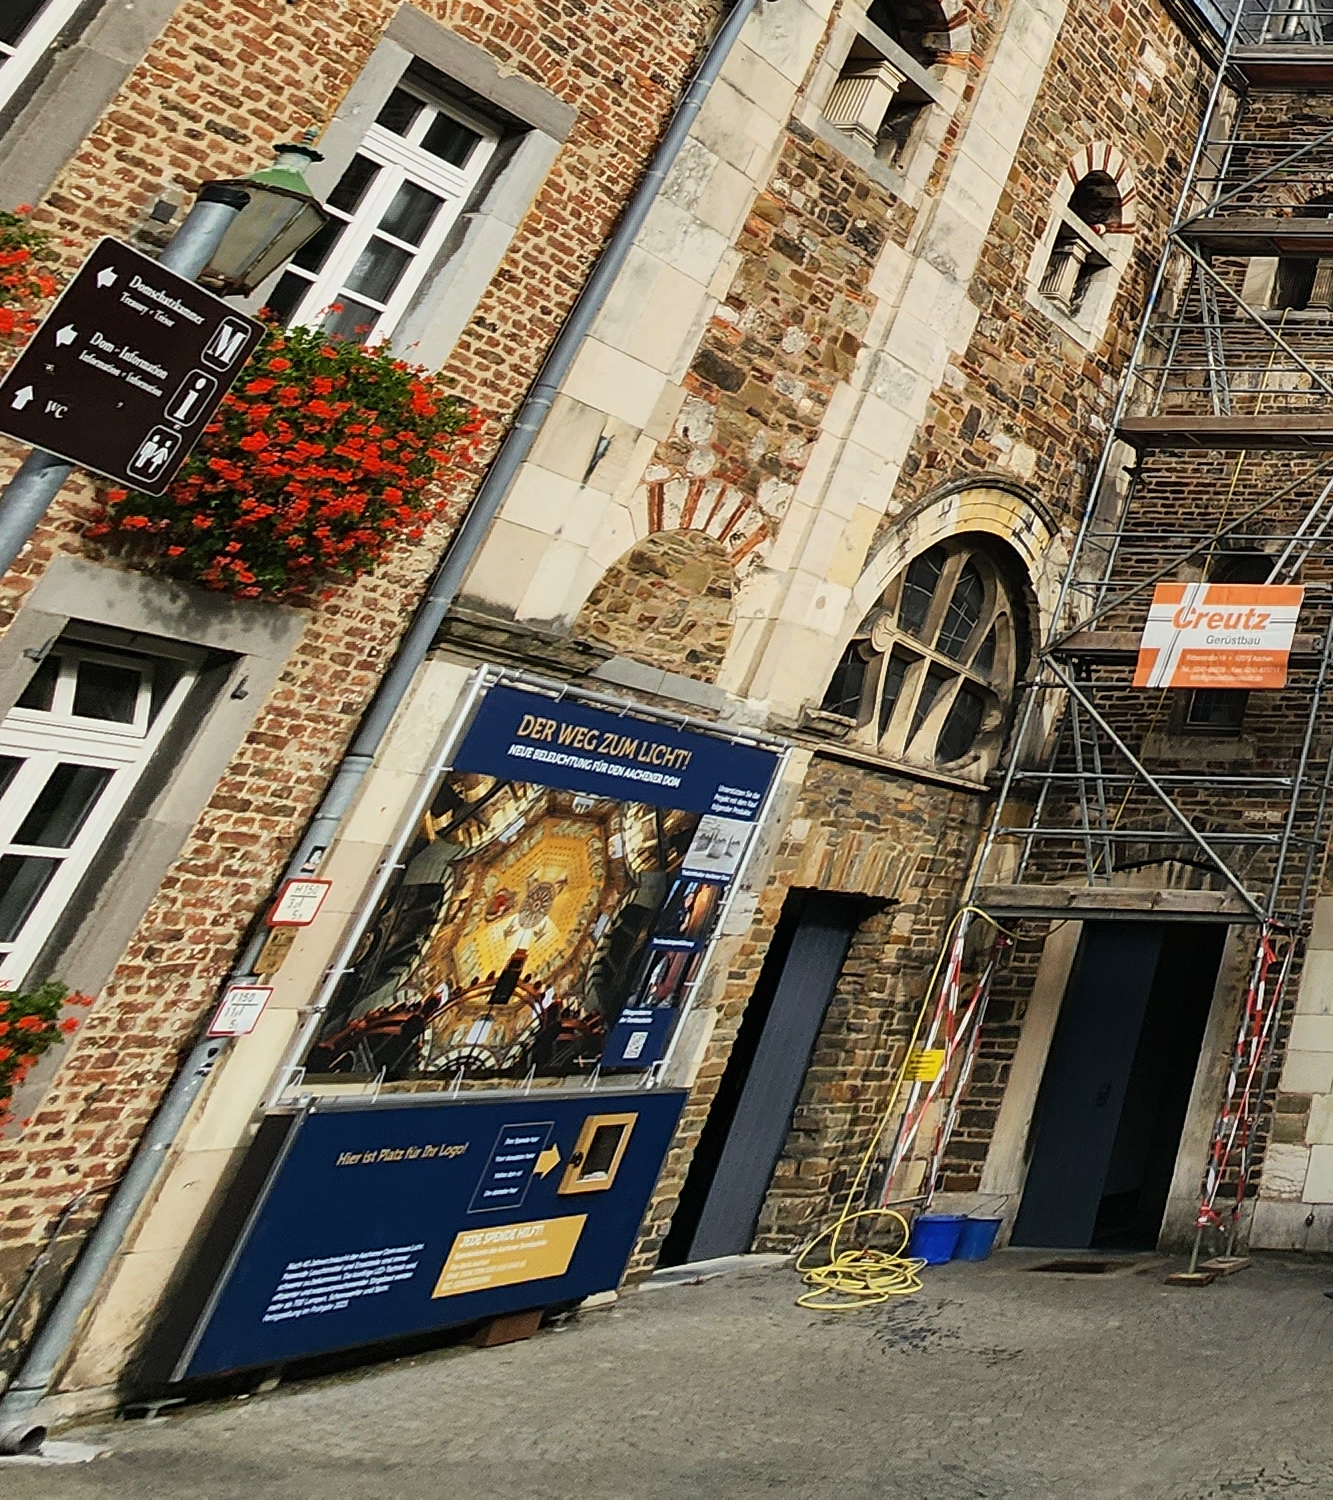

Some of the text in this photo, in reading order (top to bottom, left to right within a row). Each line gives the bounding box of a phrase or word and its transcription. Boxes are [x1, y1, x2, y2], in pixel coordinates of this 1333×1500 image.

[89, 331, 114, 353] Dom
[44, 400, 68, 418] WC
[1172, 605, 1271, 630] Creutz
[1206, 635, 1261, 645] Gerüstbau
[517, 714, 693, 771] DER WEG ZUM LICHT!
[507, 743, 682, 789] NEUE BELEUCHTUNG FÜR DEN AACHENER DOM
[335, 1141, 470, 1166] Hier ist Platz für Ihr Logo!
